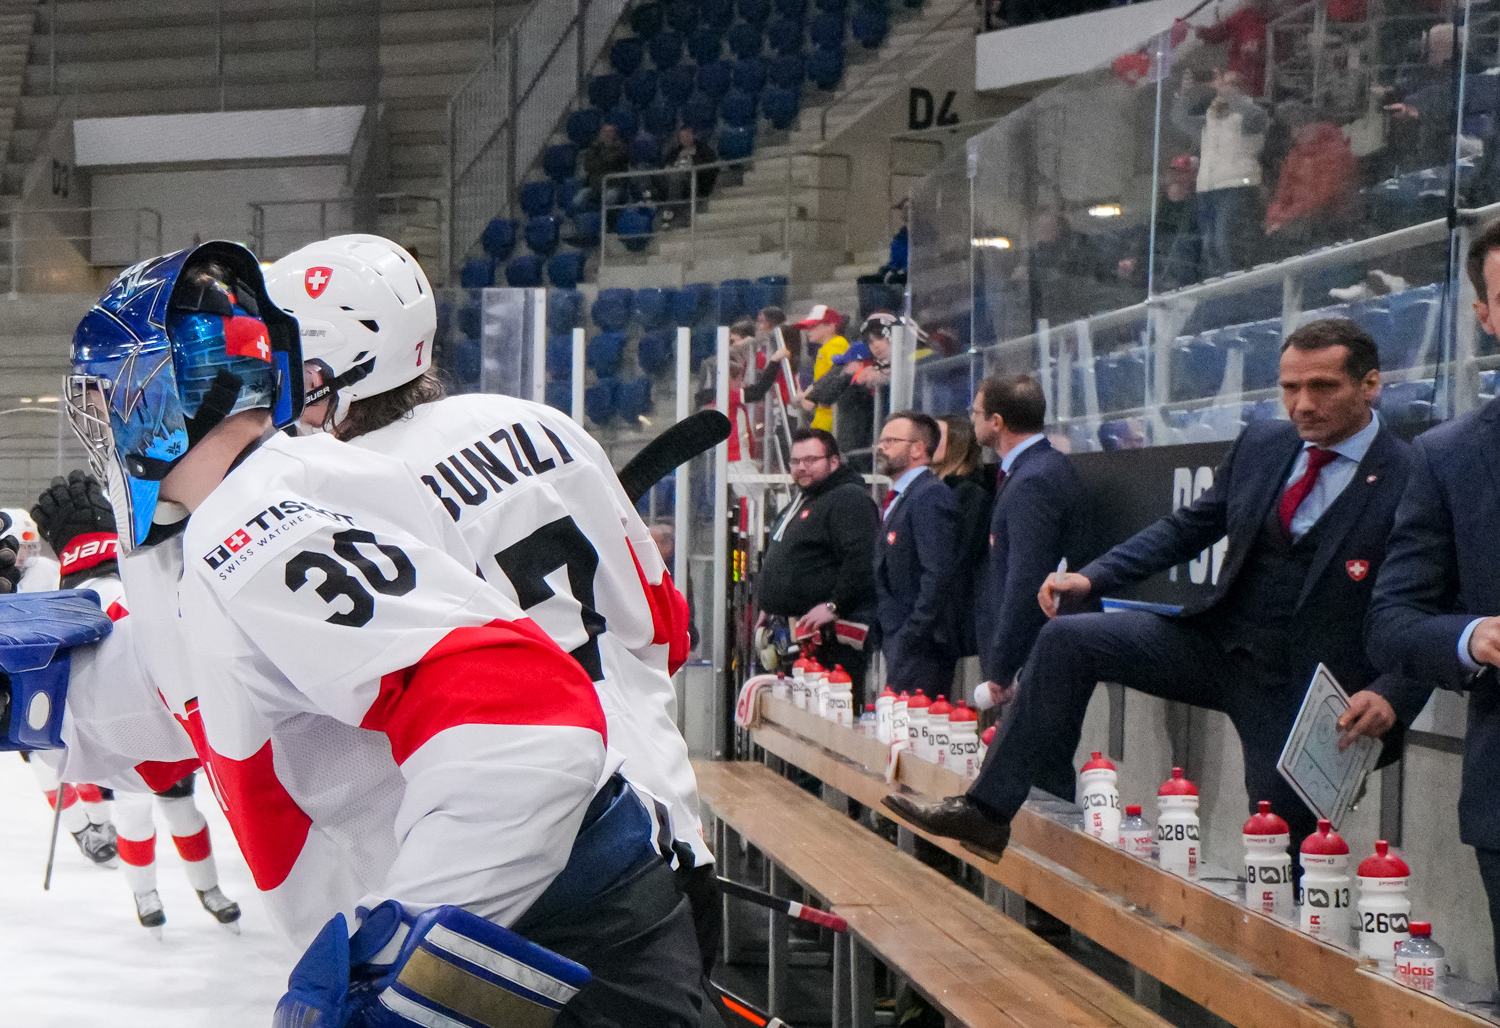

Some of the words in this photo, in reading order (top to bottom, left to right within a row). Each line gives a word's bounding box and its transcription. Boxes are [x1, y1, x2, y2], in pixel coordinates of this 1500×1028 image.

[908, 87, 960, 130] D4
[415, 340, 425, 367] 7
[218, 549, 254, 581] SWISS
[284, 528, 417, 628] 30
[1165, 824, 1185, 841] 28
[1334, 888, 1350, 909] 13
[1364, 912, 1389, 933] 26
